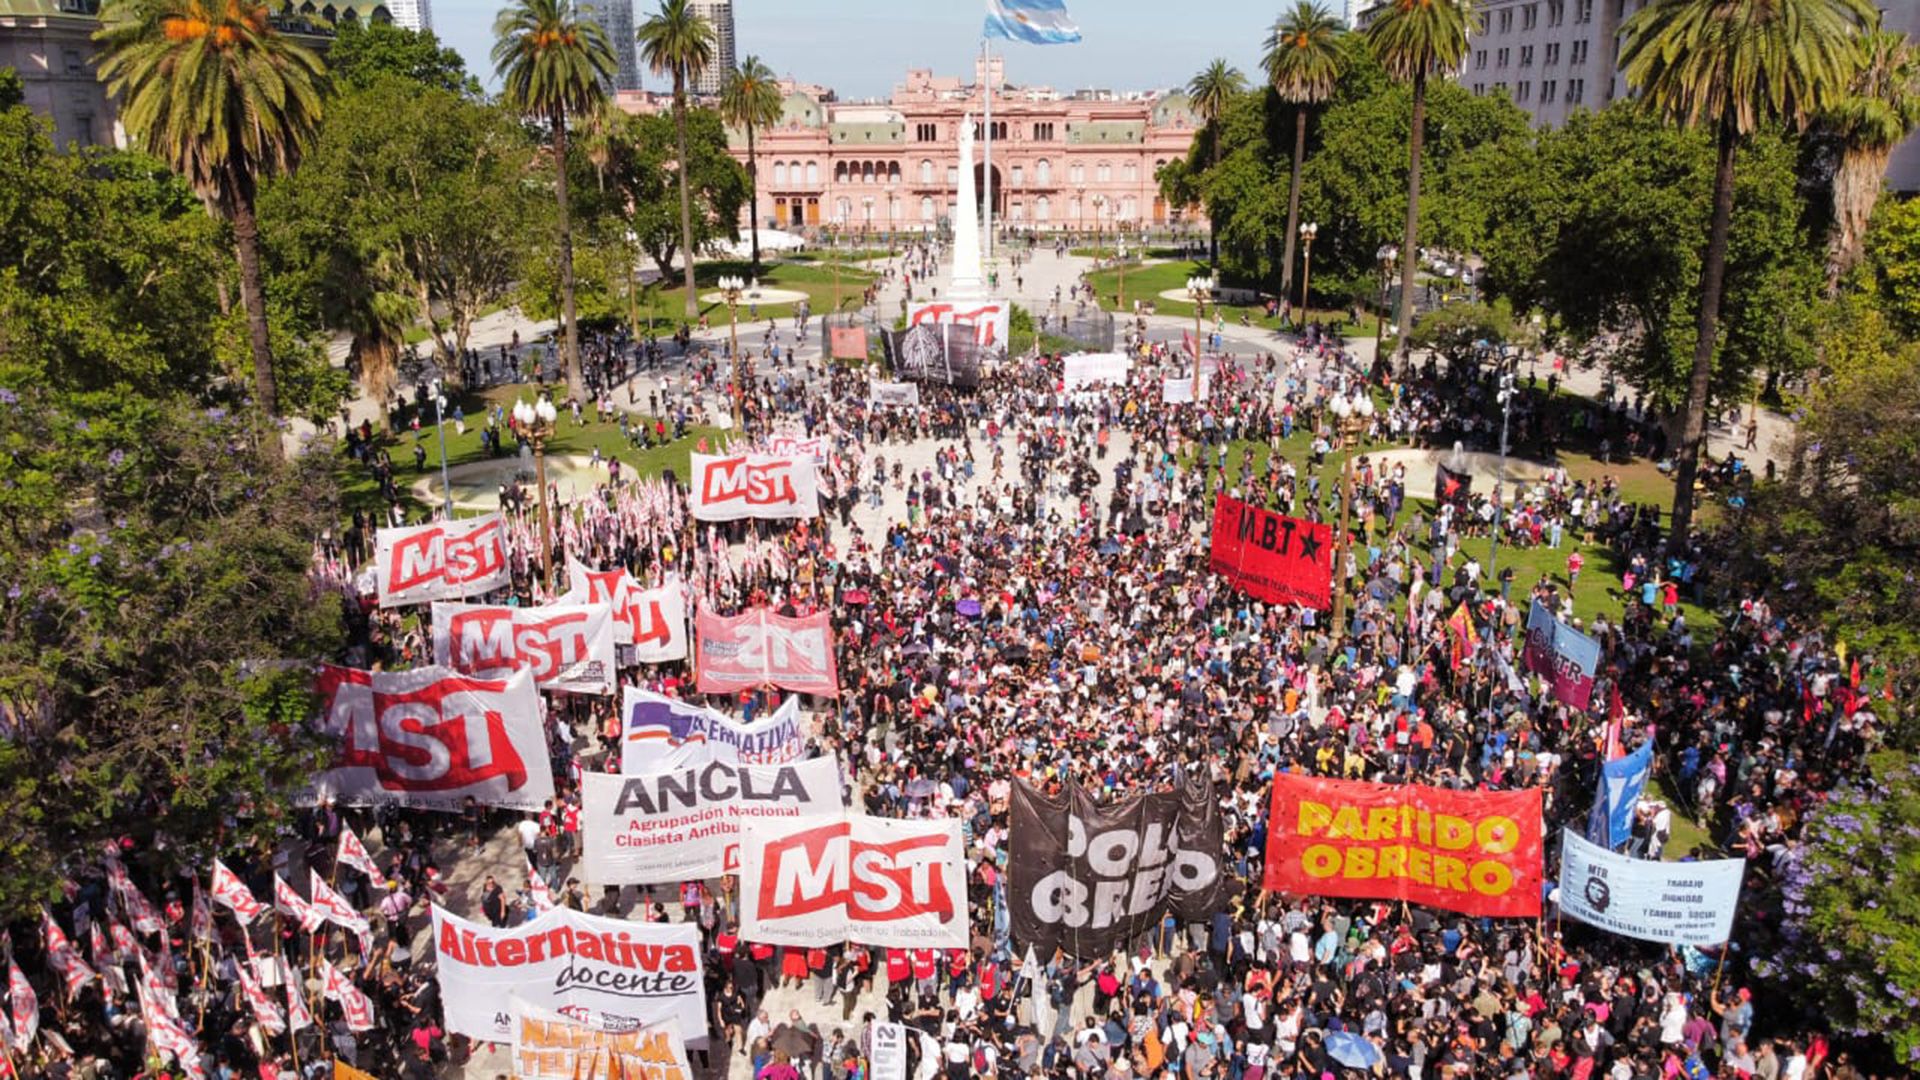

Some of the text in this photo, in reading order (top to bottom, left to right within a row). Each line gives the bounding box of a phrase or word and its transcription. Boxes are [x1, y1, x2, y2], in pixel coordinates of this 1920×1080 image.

[709, 466, 792, 501] MST
[401, 530, 499, 582] MST
[460, 619, 591, 677] MST
[322, 682, 505, 781] MST
[613, 760, 811, 815] ANCLA
[615, 833, 684, 847] Clasista
[629, 805, 800, 832] Agrupación Nacional
[1297, 801, 1520, 854] PARTIDO
[773, 834, 951, 913] MST
[1301, 844, 1514, 896] OBRERO
[439, 917, 697, 973] Alternativa
[556, 956, 695, 994] docente
